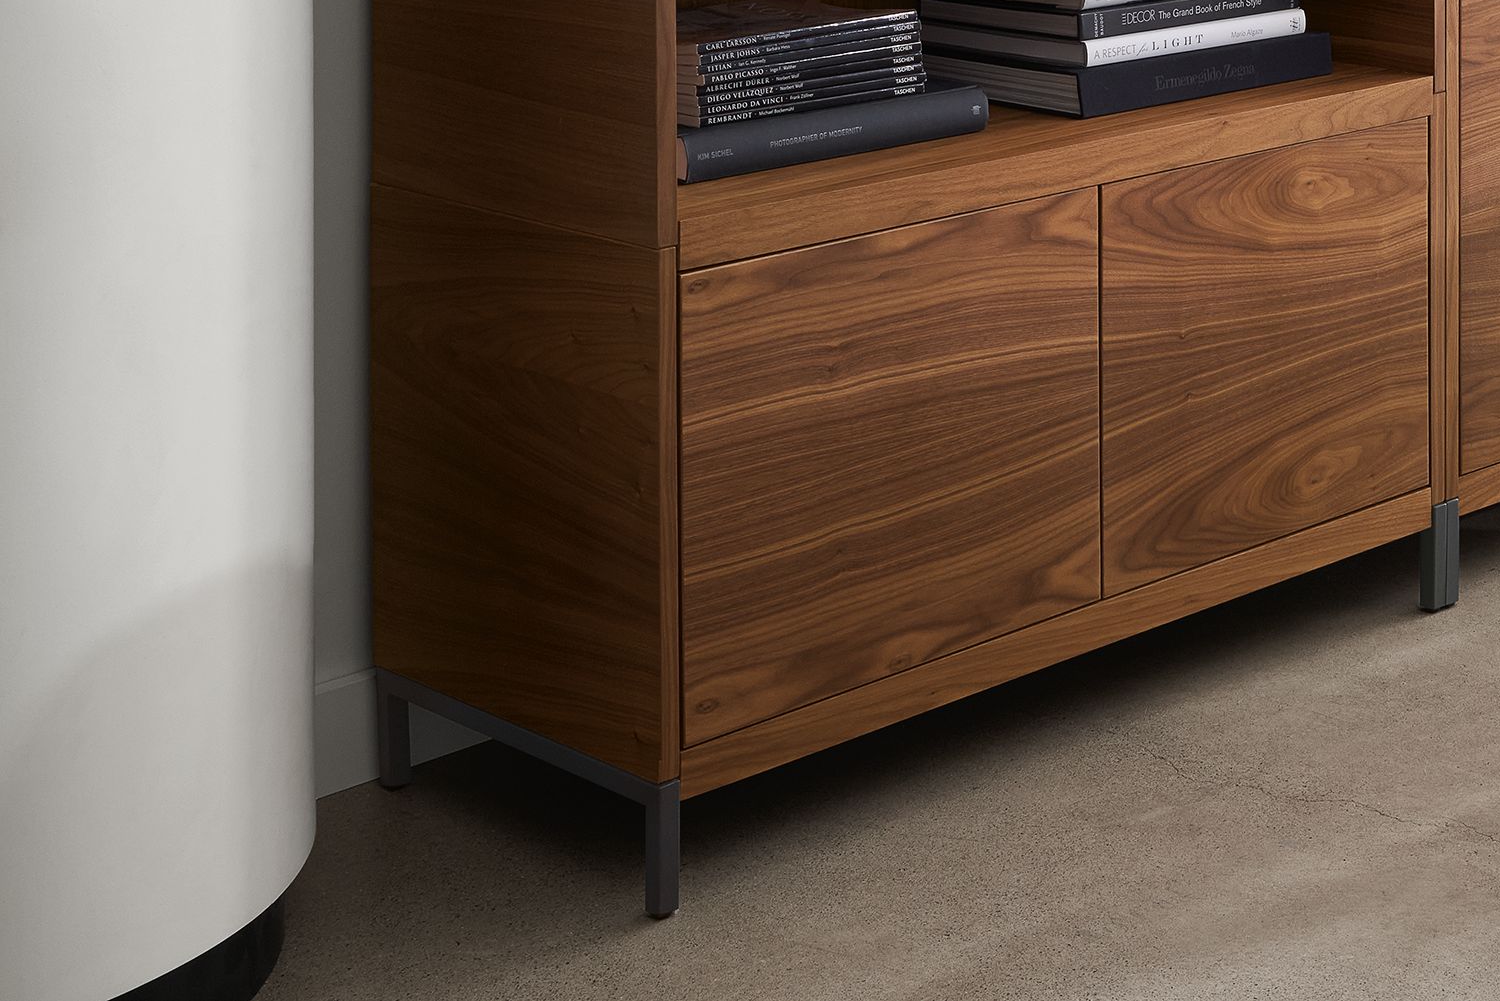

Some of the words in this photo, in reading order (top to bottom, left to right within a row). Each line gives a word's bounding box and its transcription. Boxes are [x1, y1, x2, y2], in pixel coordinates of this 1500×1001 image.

[1158, 10, 1171, 20] The
[1172, 7, 1194, 18] Grand
[1195, 4, 1213, 15] Book
[1214, 3, 1221, 12] of
[1222, 0, 1245, 10] French
[705, 43, 724, 51] CARL
[725, 37, 757, 48] LARSSON
[710, 52, 735, 63] JASPER
[736, 48, 760, 58] JOHNS
[893, 24, 914, 32] TASCHEN
[1093, 50, 1100, 60] A
[1102, 44, 1137, 58] RESPECT
[1152, 34, 1204, 51] LIGHT
[1231, 30, 1247, 38] Mario
[705, 81, 743, 93] ALBRECHT
[745, 77, 770, 87] DÜRER
[893, 56, 914, 64] TASCHEN
[707, 63, 732, 73] TITIAN
[711, 74, 734, 83] PABLO
[735, 69, 764, 79] PICASSO
[892, 45, 913, 53] TASCHEN
[1154, 66, 1222, 91] Ermenegildo
[1223, 63, 1256, 80] Zegna
[707, 93, 731, 104] DIEGO
[733, 86, 774, 101] VELÁZQUEZ
[893, 65, 914, 73] TASCHEN
[707, 102, 748, 114] LEONARDO
[750, 100, 761, 108] DA
[762, 96, 784, 105] VINCI
[895, 76, 917, 84] TASCHEN
[707, 112, 753, 125] REMBRANDT
[769, 133, 818, 148] PHOTOGRAPHER
[819, 131, 828, 140] OF
[828, 126, 863, 138] MODERNITY
[697, 152, 710, 161] KIM
[711, 149, 734, 158] SICHEL
